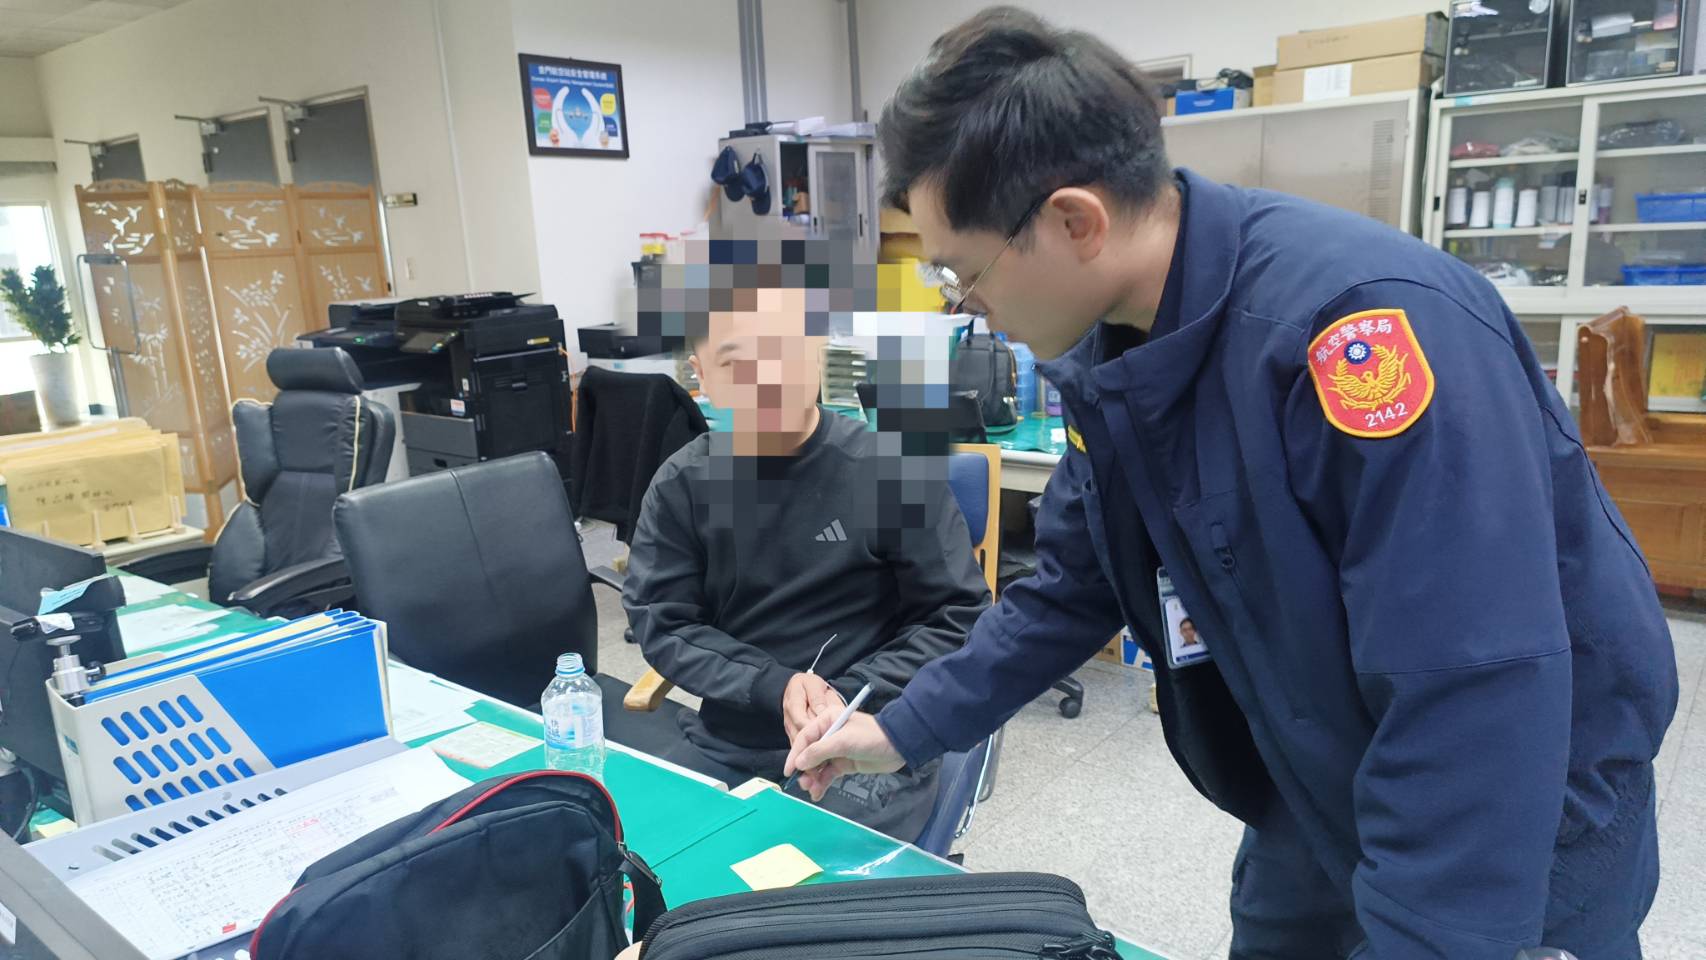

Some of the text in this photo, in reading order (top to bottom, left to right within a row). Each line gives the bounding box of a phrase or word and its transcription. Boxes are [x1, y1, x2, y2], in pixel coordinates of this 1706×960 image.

[1316, 318, 1393, 365] 航空警察局
[1364, 402, 1408, 428] 2142
